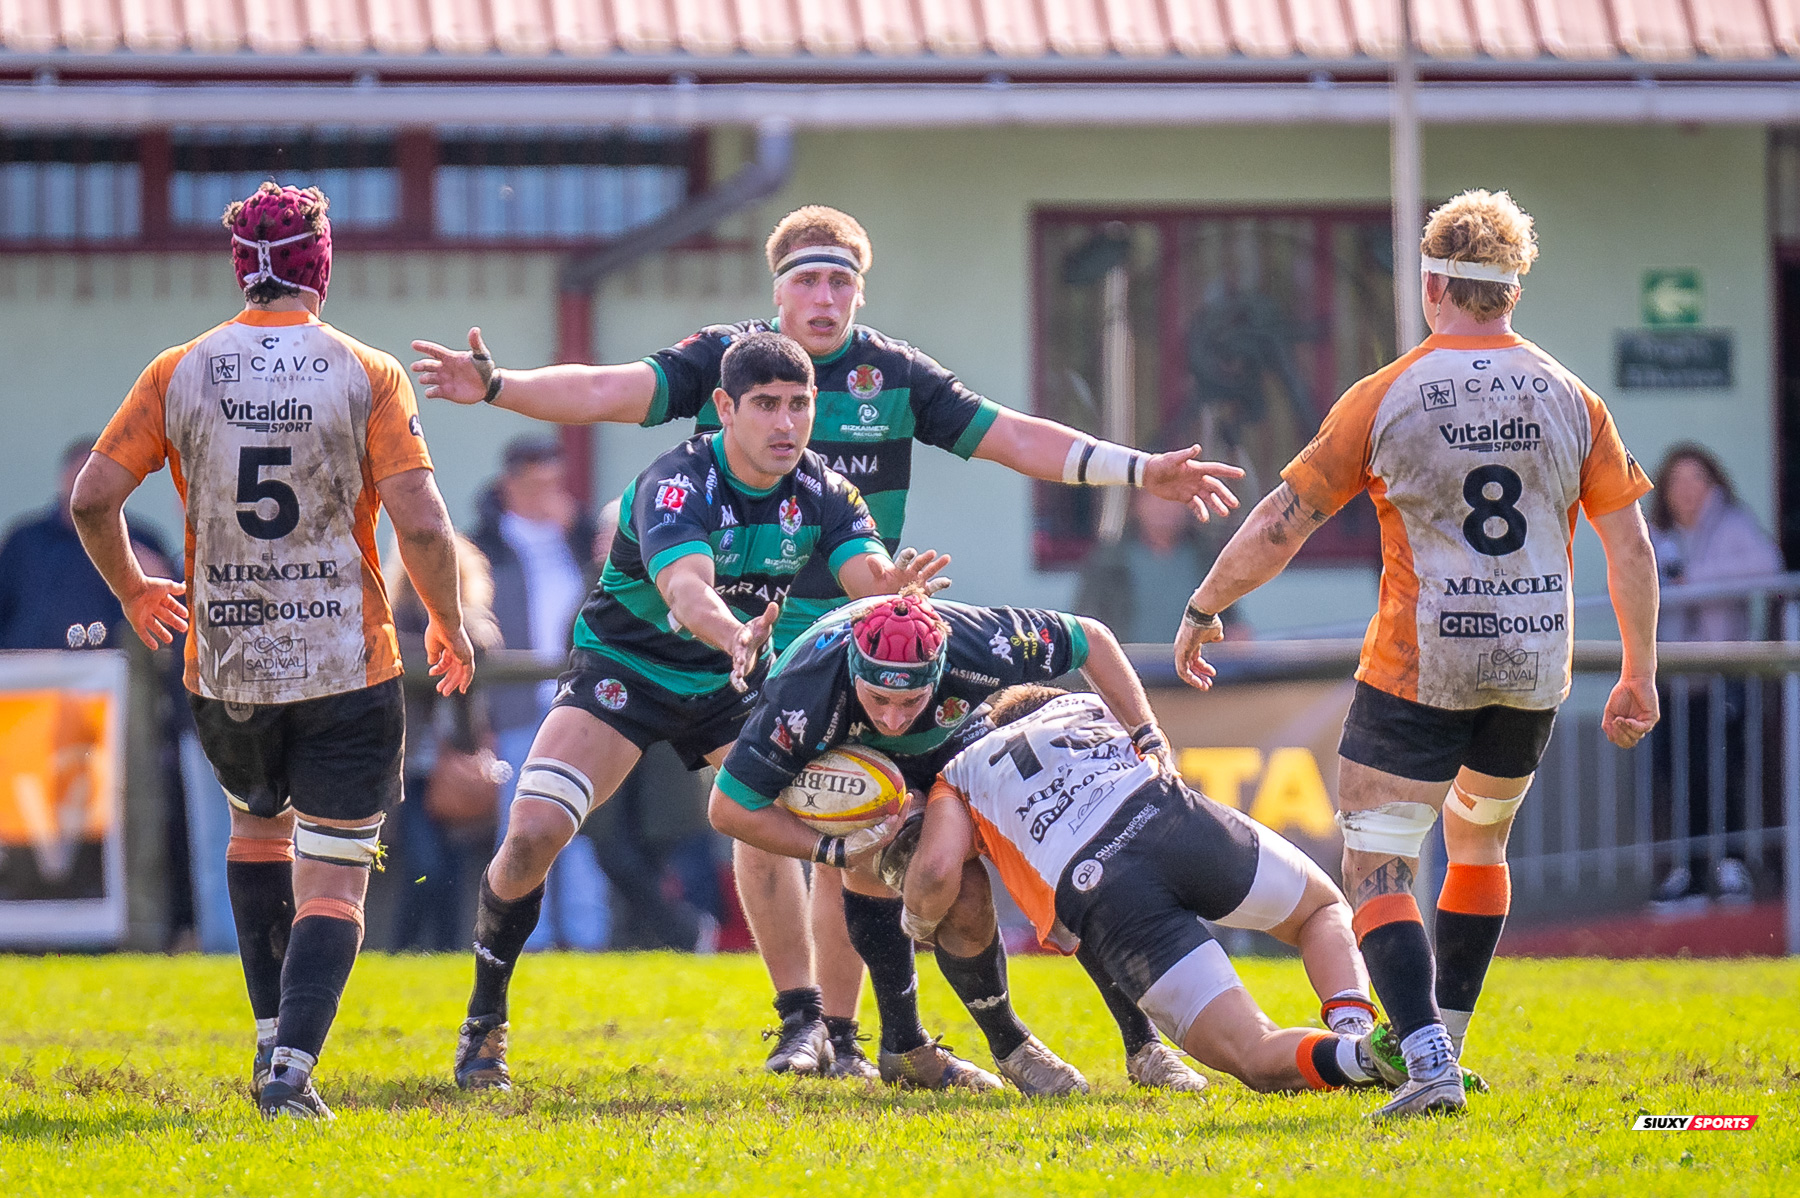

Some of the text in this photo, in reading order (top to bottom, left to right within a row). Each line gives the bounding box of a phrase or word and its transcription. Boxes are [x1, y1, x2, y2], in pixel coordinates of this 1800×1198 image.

[250, 356, 329, 373] CAVO
[1465, 375, 1549, 393] CAVO
[220, 397, 313, 421] Vitaldin
[270, 421, 313, 433] SPORT
[1439, 416, 1541, 445] Vitaldin
[1493, 440, 1541, 453] SPORT
[236, 446, 300, 540] 5
[1462, 464, 1528, 556] 8
[261, 552, 278, 560] EL
[206, 560, 338, 583] MIRACLE
[1494, 568, 1508, 576] EL
[1443, 573, 1563, 596] MIRACLE
[208, 600, 342, 624] CRISCOLOR
[1441, 613, 1565, 635] CRISCOLOR
[246, 657, 304, 671] SADIVAL
[950, 666, 1001, 685] ASIMAIR
[1482, 670, 1535, 681] SADIVAL
